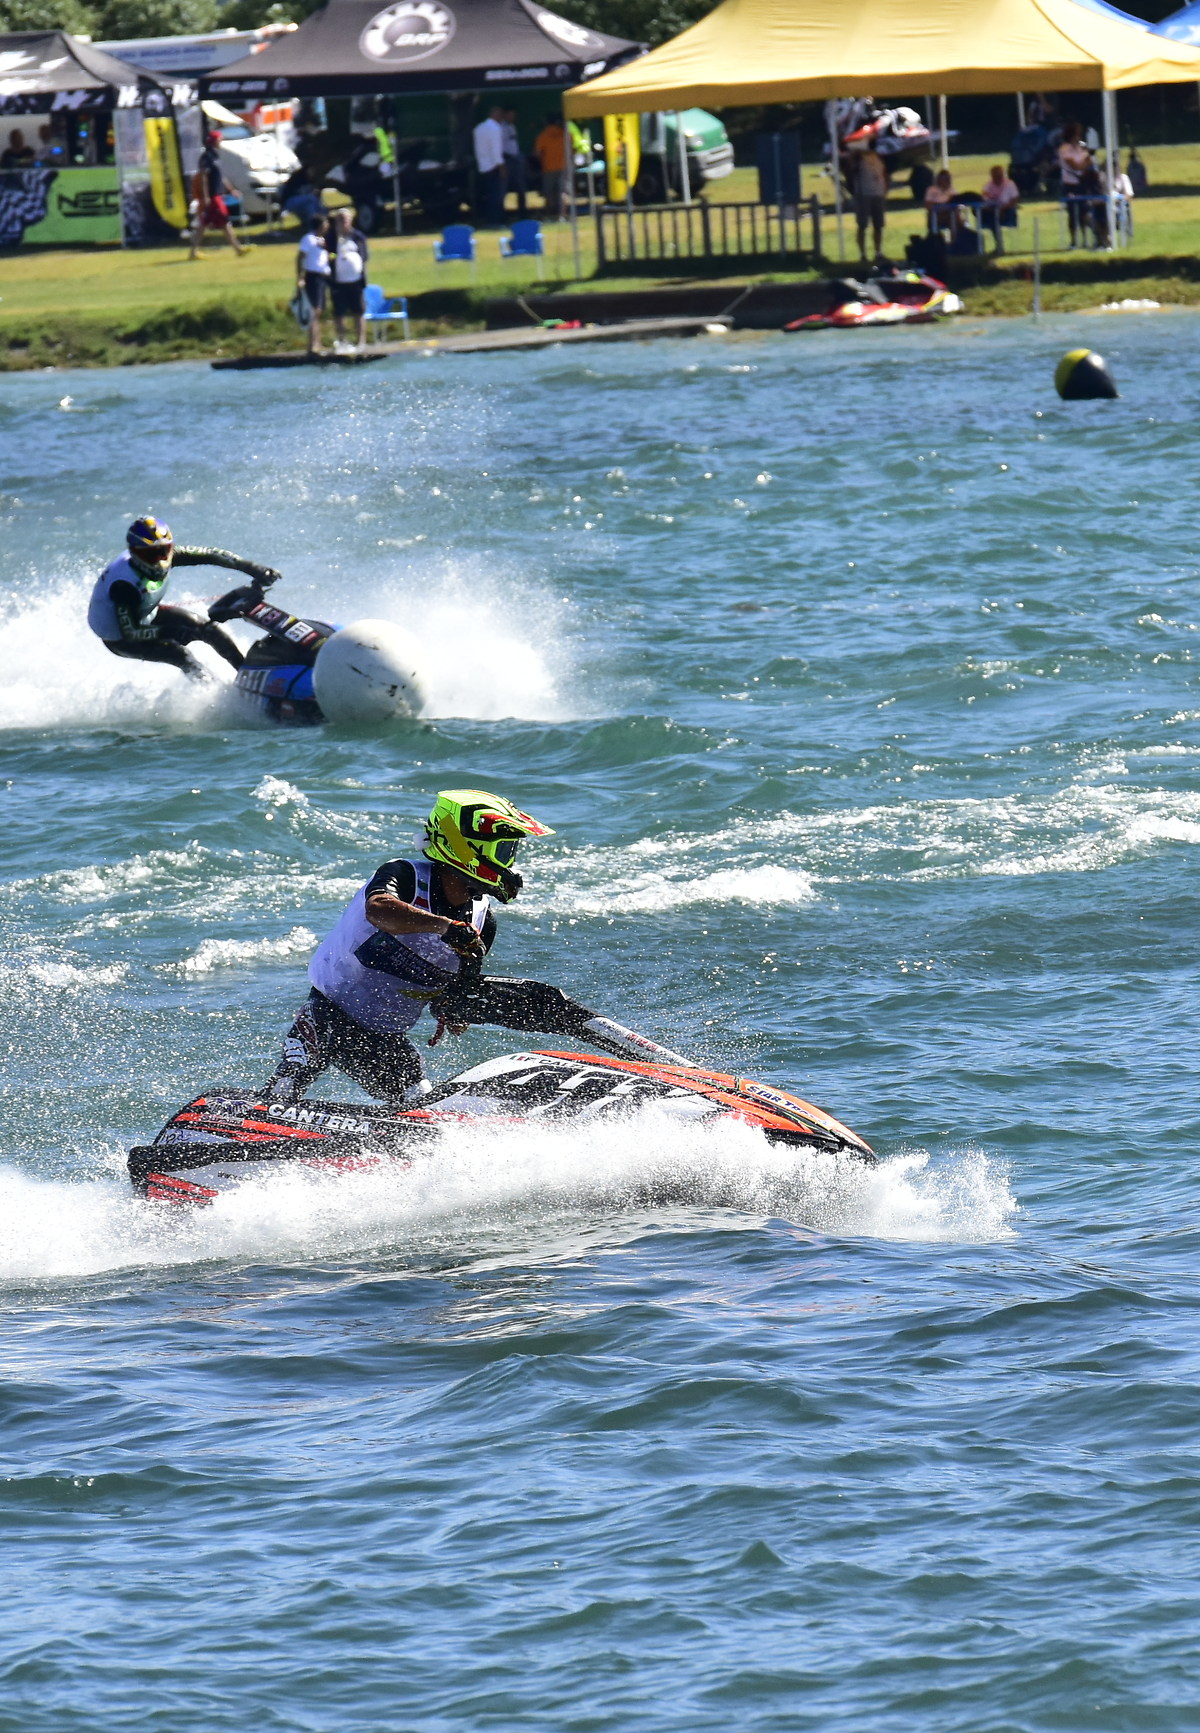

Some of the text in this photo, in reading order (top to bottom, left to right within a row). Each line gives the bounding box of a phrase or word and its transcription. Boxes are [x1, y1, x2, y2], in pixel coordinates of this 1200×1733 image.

[394, 32, 449, 47] BRP
[746, 1085, 782, 1104] STAR
[268, 1103, 371, 1135] CANTERA
